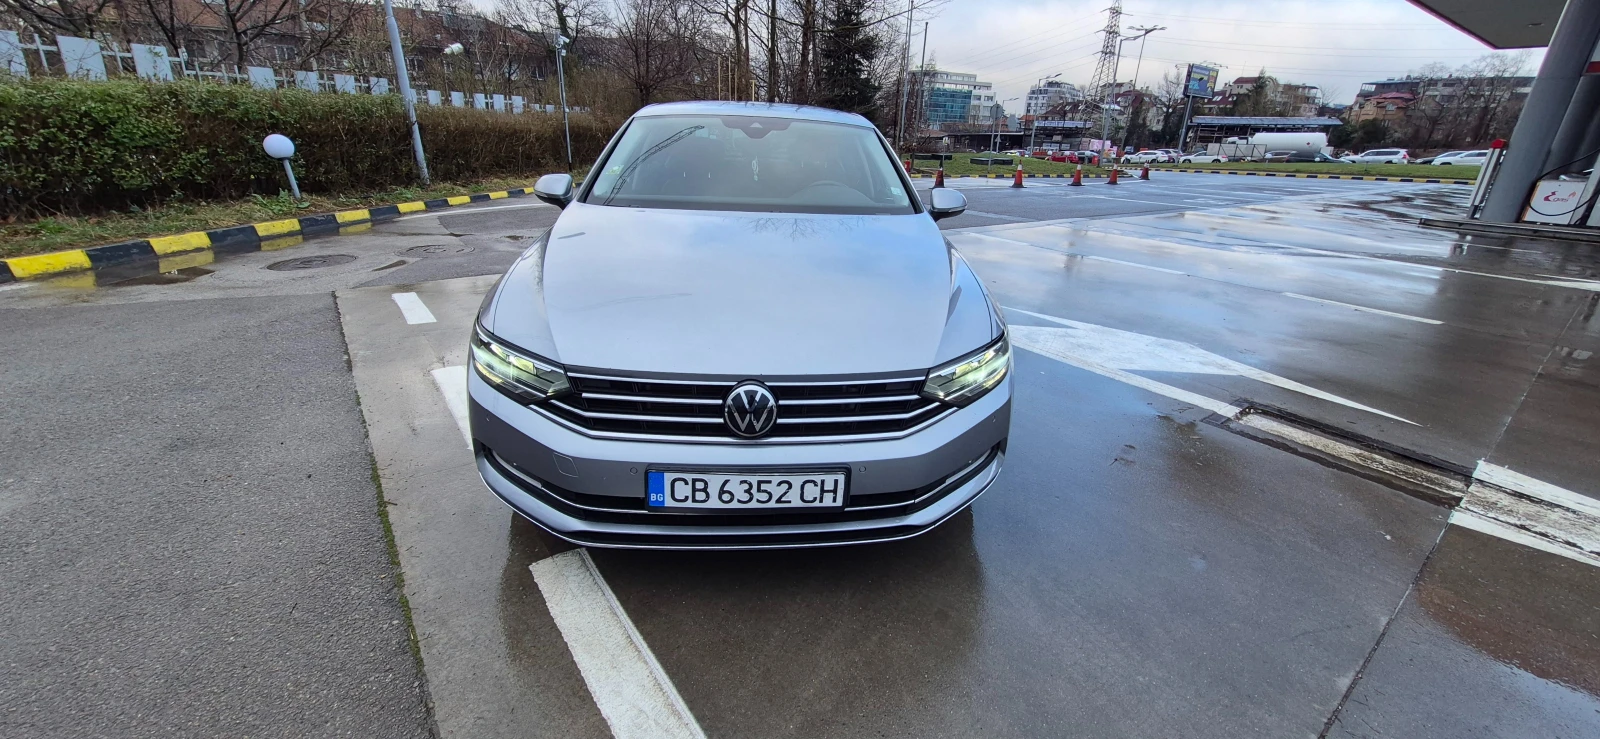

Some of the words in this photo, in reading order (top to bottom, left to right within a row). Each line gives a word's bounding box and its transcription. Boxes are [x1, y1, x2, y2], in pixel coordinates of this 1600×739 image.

[650, 493, 664, 502] BG
[670, 477, 710, 503] CB
[717, 479, 793, 504] 6352
[799, 479, 839, 503] CH
